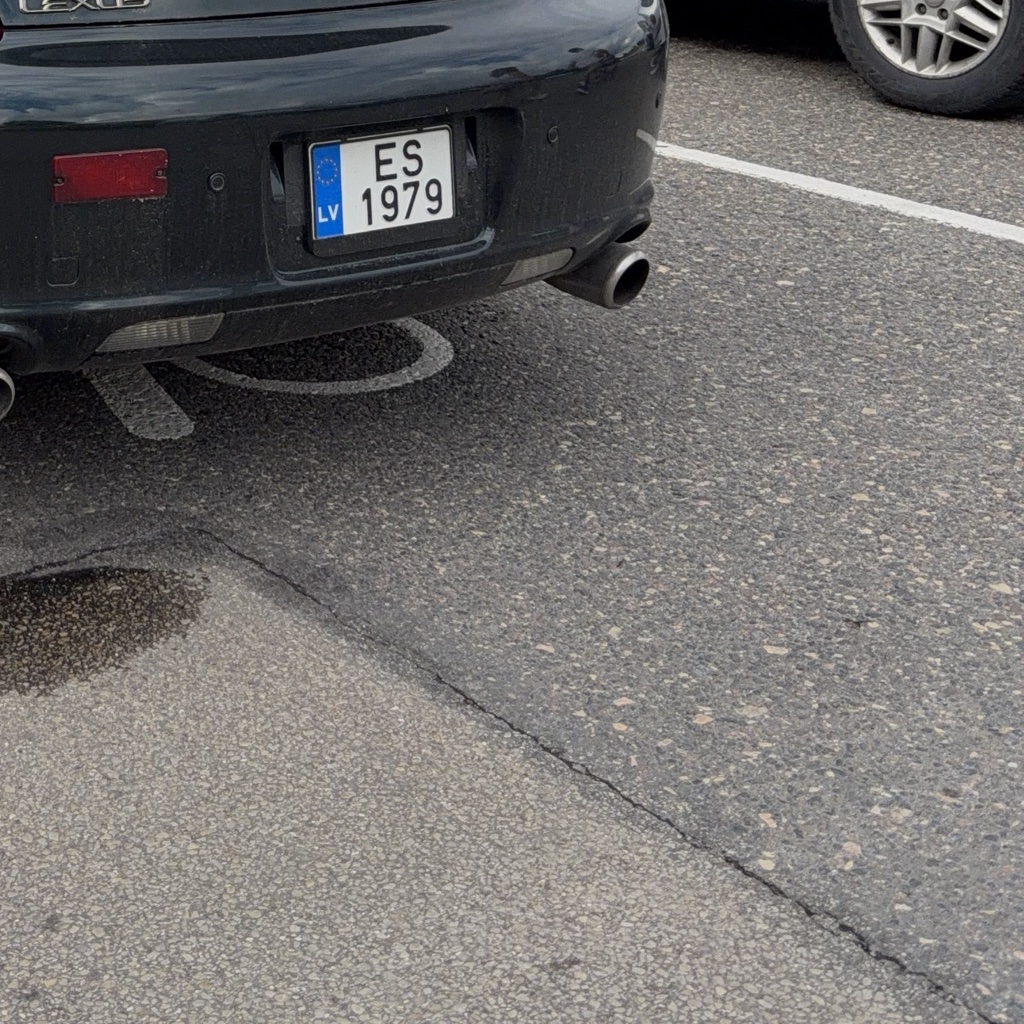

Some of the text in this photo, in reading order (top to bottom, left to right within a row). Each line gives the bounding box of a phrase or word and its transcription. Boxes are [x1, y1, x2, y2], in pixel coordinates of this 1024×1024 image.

[375, 139, 423, 182] ES
[318, 204, 339, 223] LV
[362, 178, 442, 226] 1979
